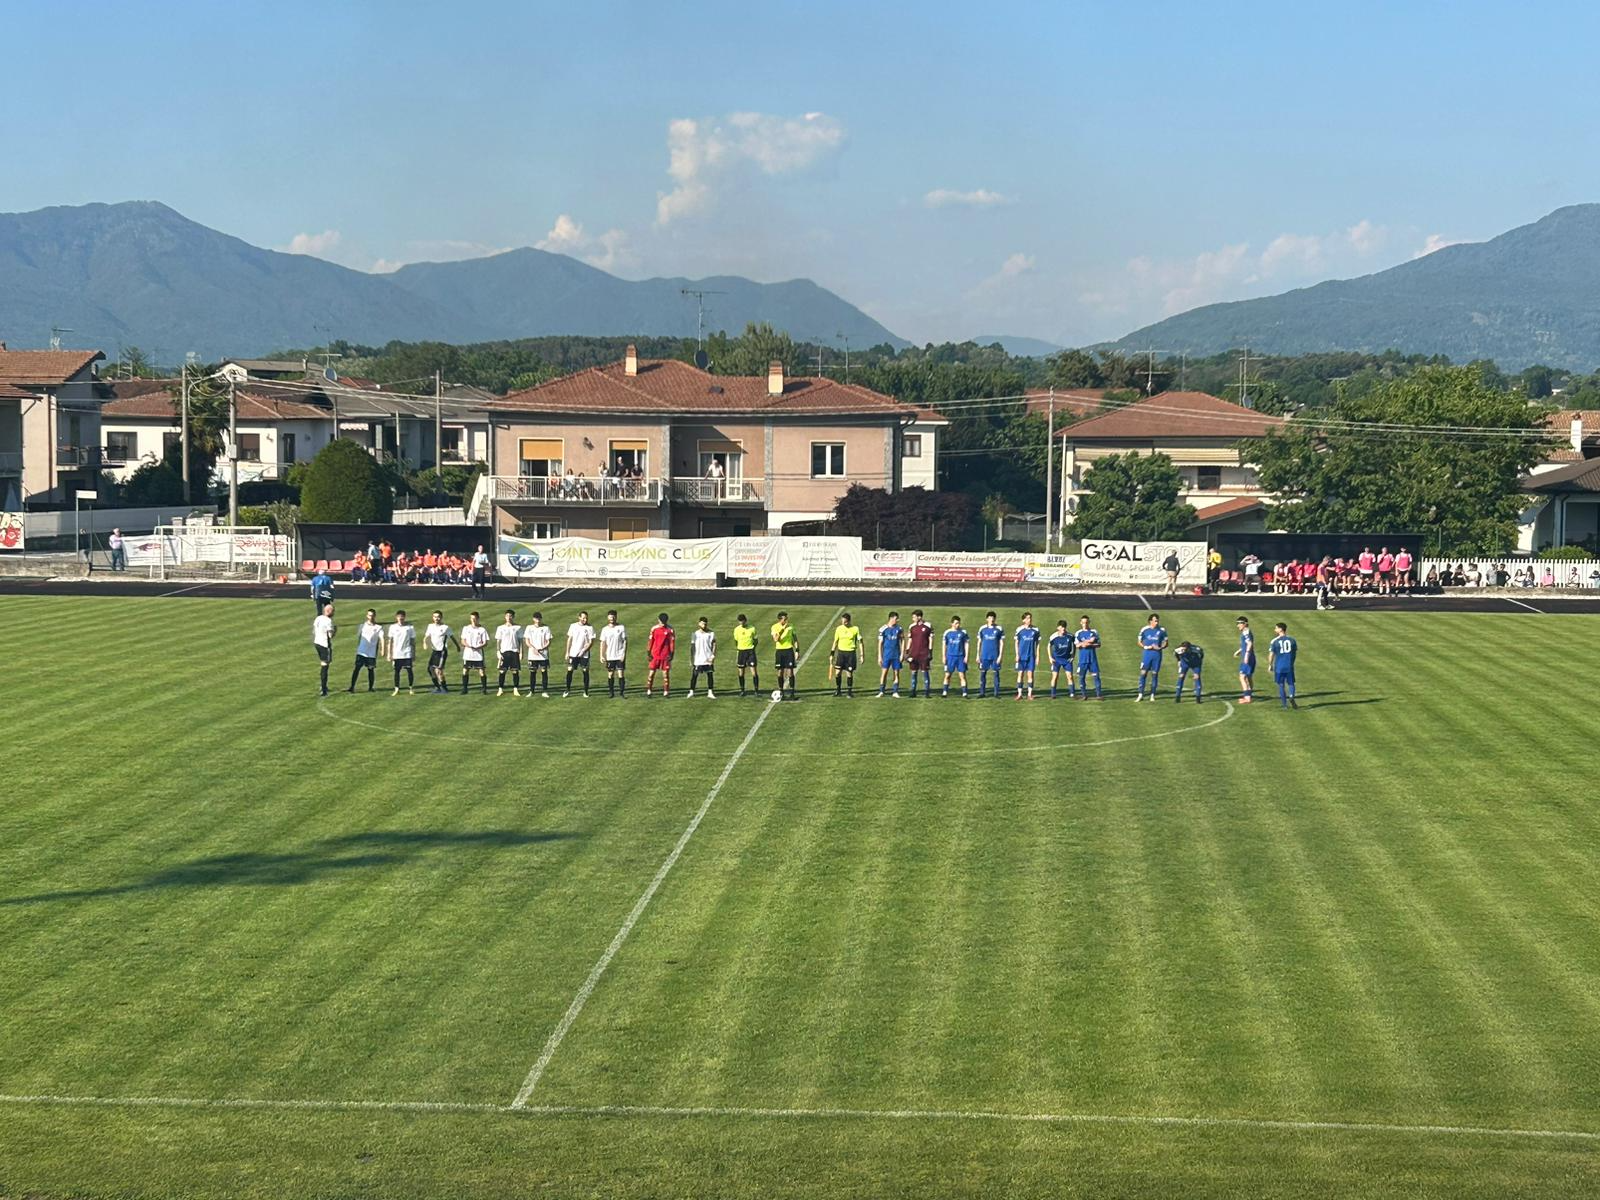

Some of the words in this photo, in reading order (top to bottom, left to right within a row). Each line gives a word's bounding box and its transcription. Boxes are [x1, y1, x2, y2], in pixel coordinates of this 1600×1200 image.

[548, 547, 592, 560] JOINT
[598, 548, 667, 559] RUNNING
[672, 548, 711, 560] CLUB
[1084, 544, 1142, 560] GOAL
[1278, 639, 1291, 654] 10
